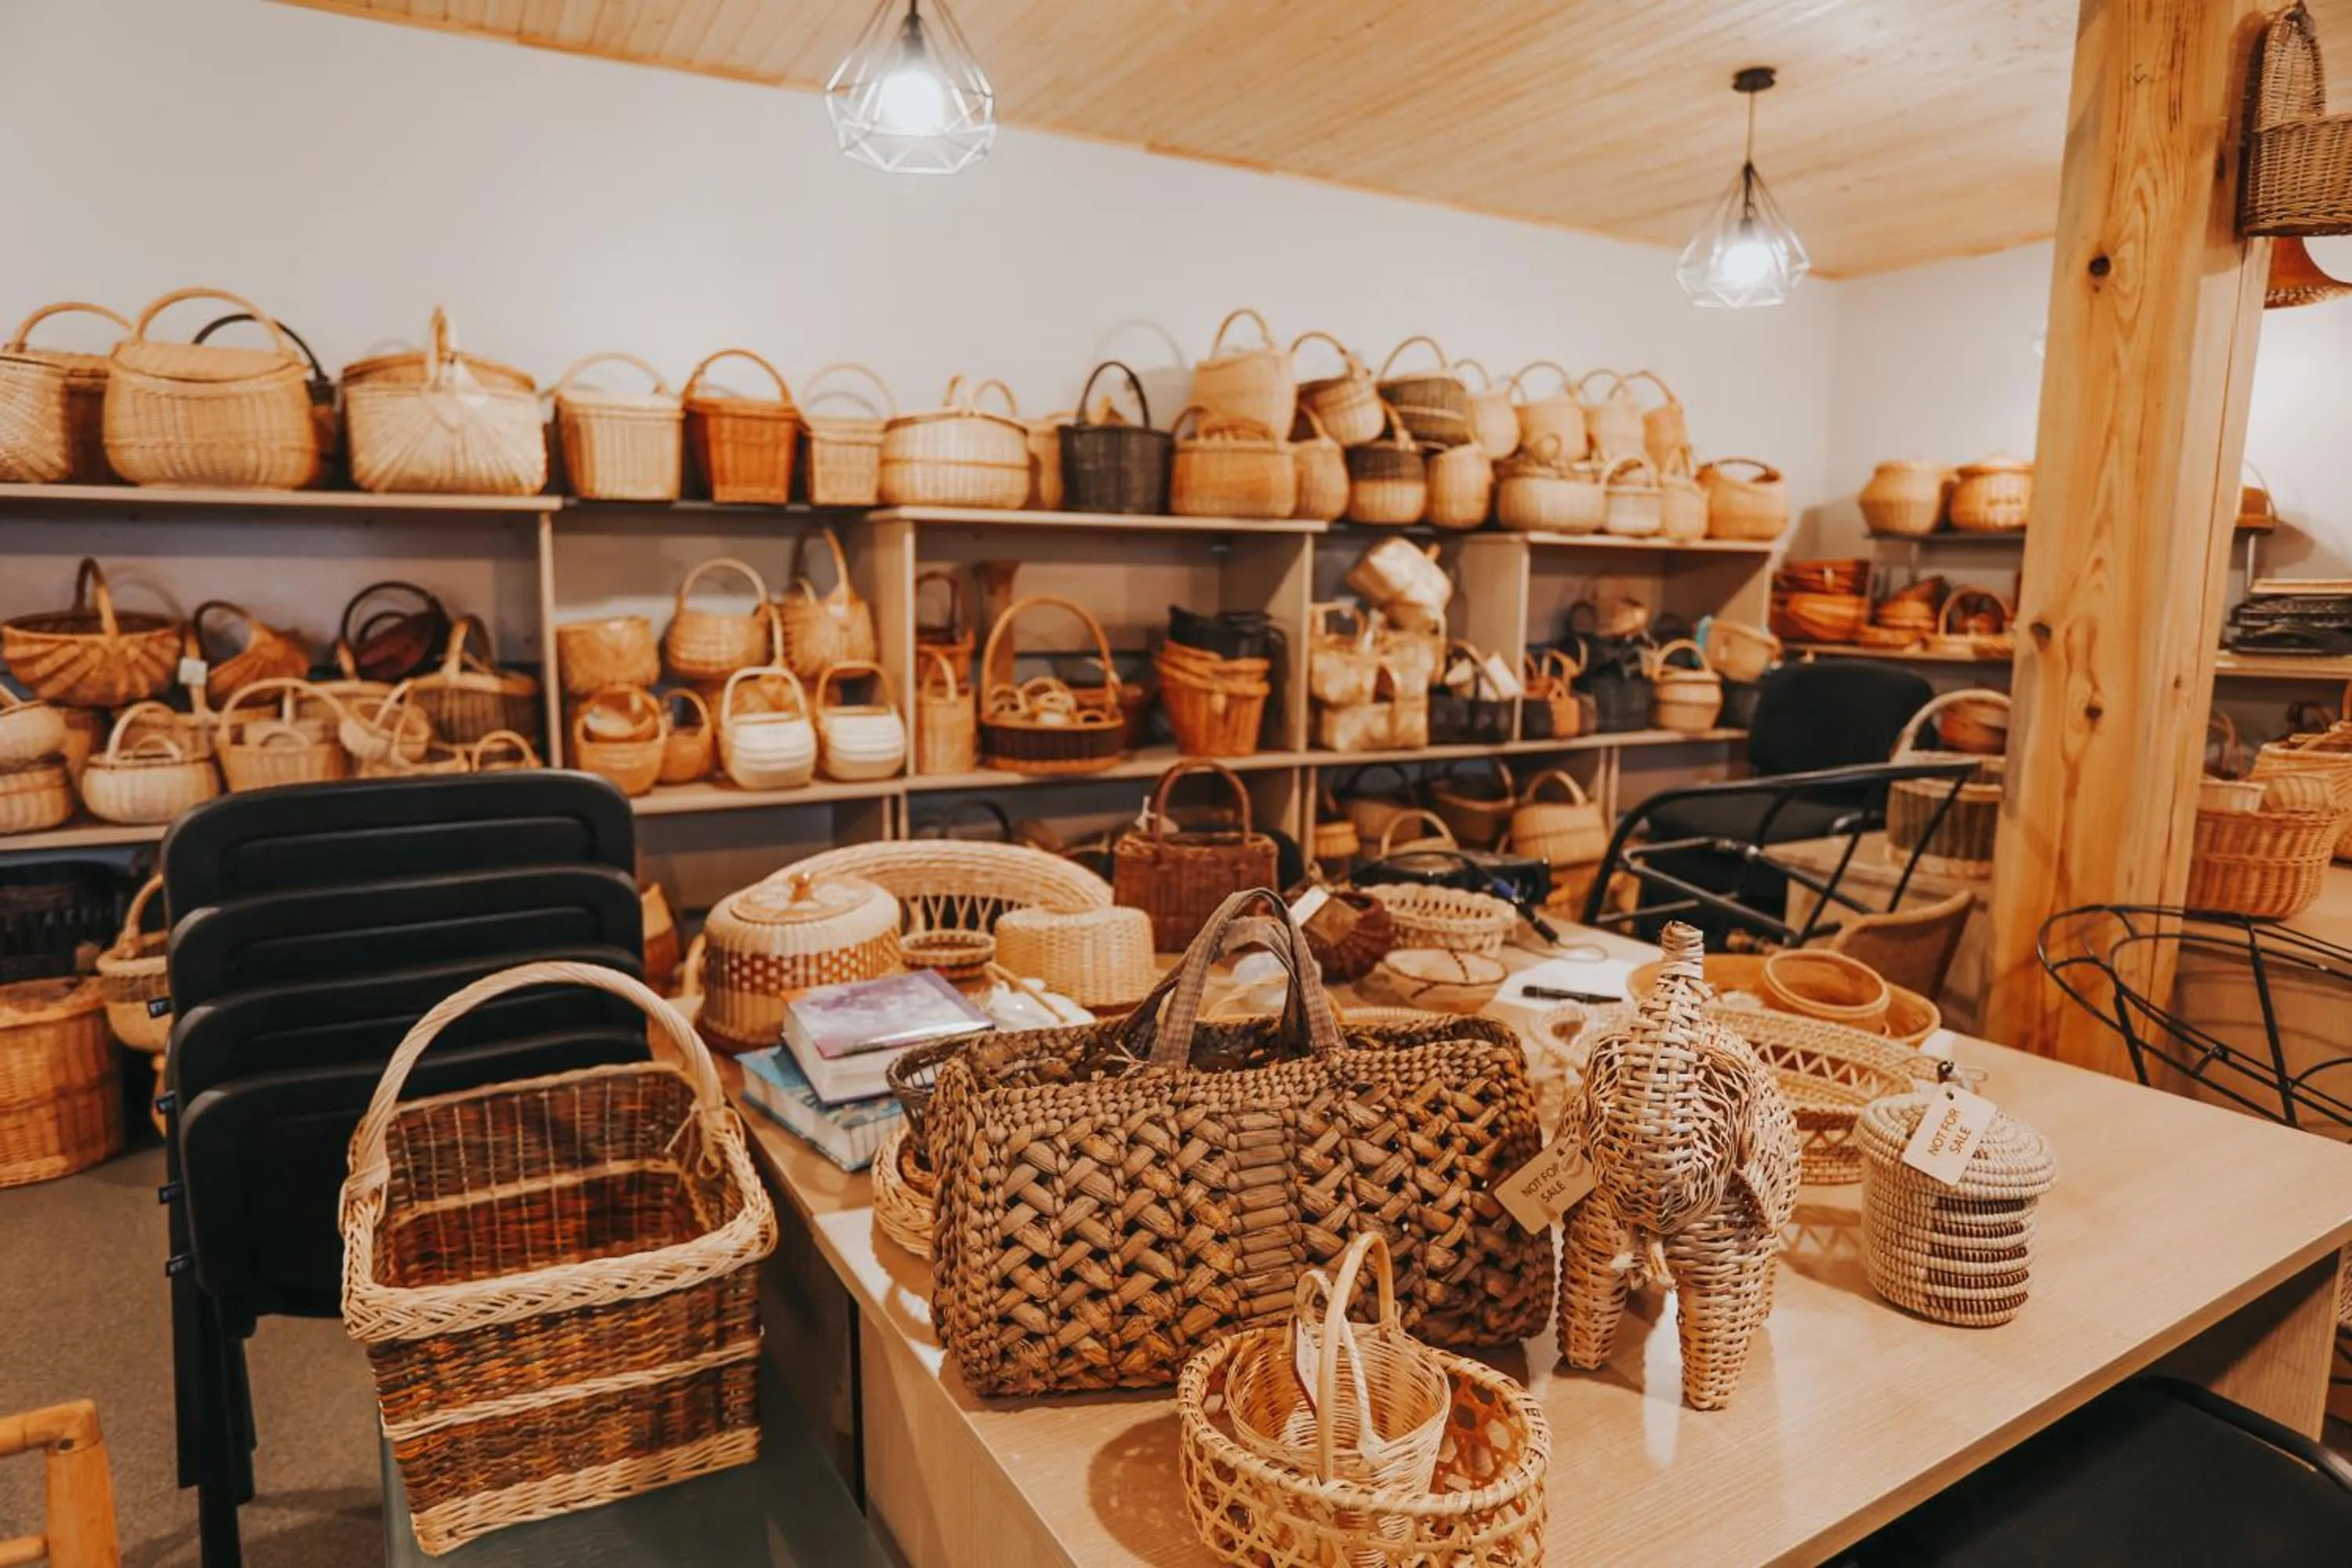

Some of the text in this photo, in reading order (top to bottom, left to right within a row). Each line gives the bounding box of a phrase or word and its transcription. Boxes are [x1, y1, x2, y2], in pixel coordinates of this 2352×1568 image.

[1926, 1107, 1962, 1156] NOT FOR
[1948, 1125, 1972, 1155] SALE
[1521, 1177, 1542, 1198] NOT
[1541, 1179, 1566, 1204] SALE
